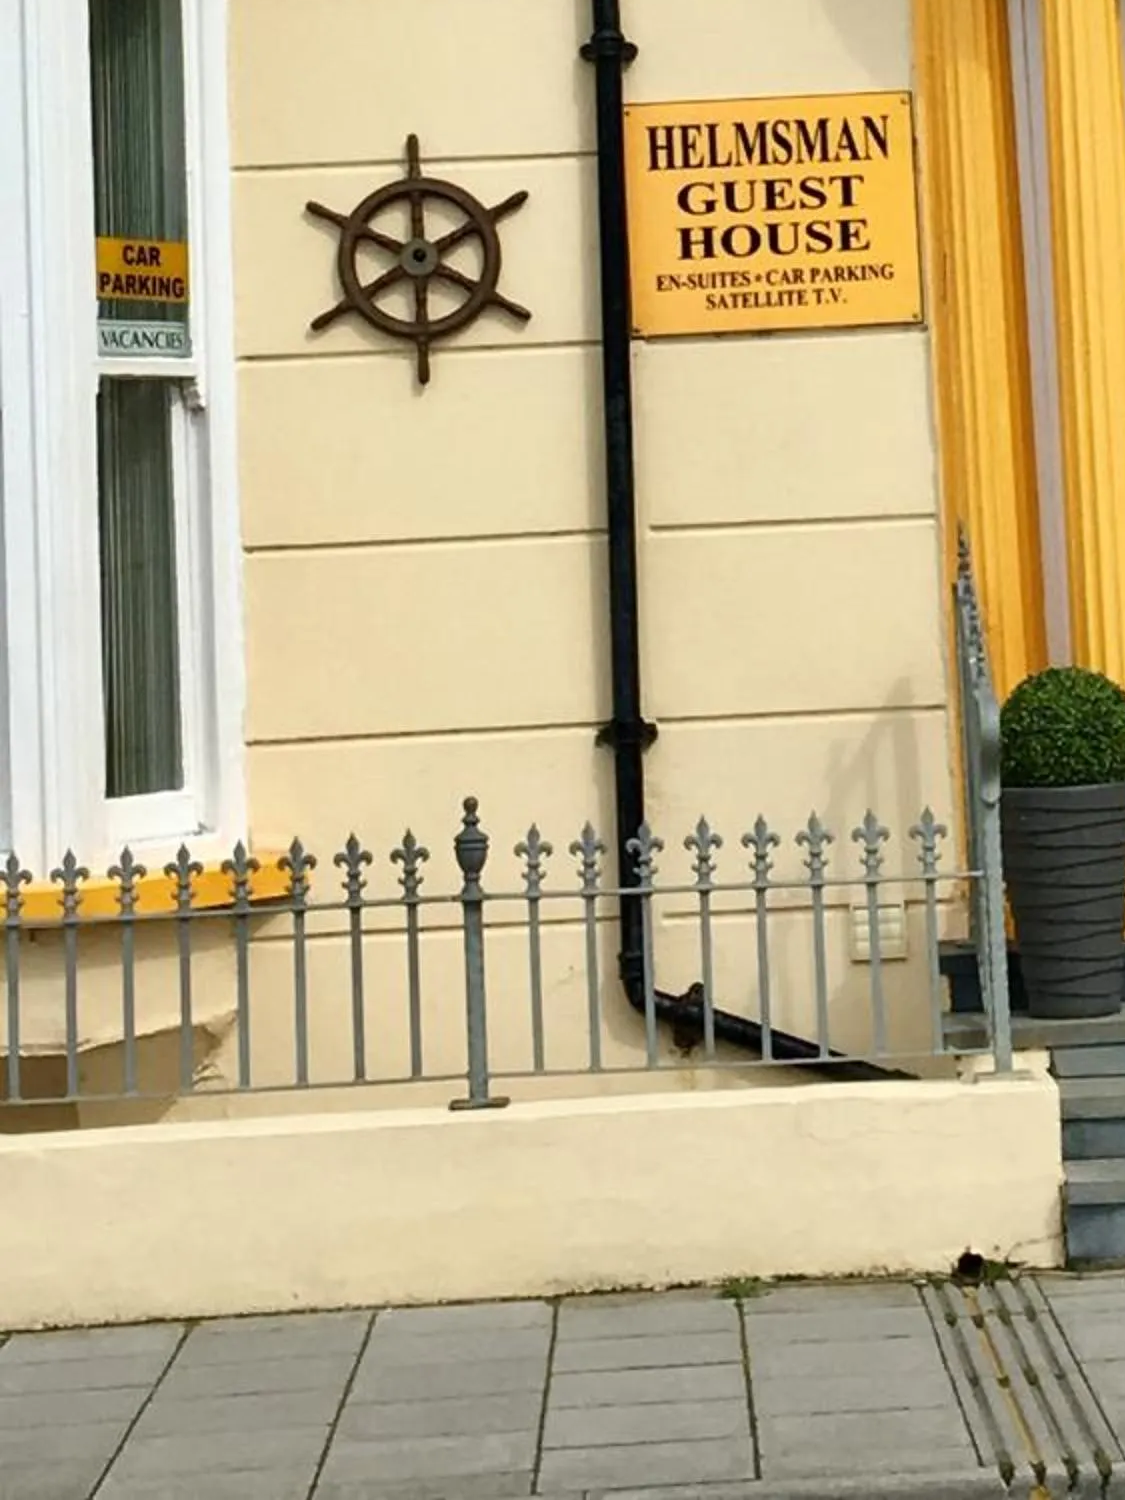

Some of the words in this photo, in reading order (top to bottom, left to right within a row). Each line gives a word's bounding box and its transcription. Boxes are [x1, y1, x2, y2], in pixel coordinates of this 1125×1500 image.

[645, 115, 890, 171] HELMSMAN
[677, 174, 864, 216] GUEST
[676, 219, 870, 260] HOUSE
[122, 244, 162, 267] CAR
[98, 272, 185, 298] PARKING
[809, 263, 895, 284] PARKING
[706, 288, 808, 310] SATELLITE
[814, 287, 848, 304] T.V.
